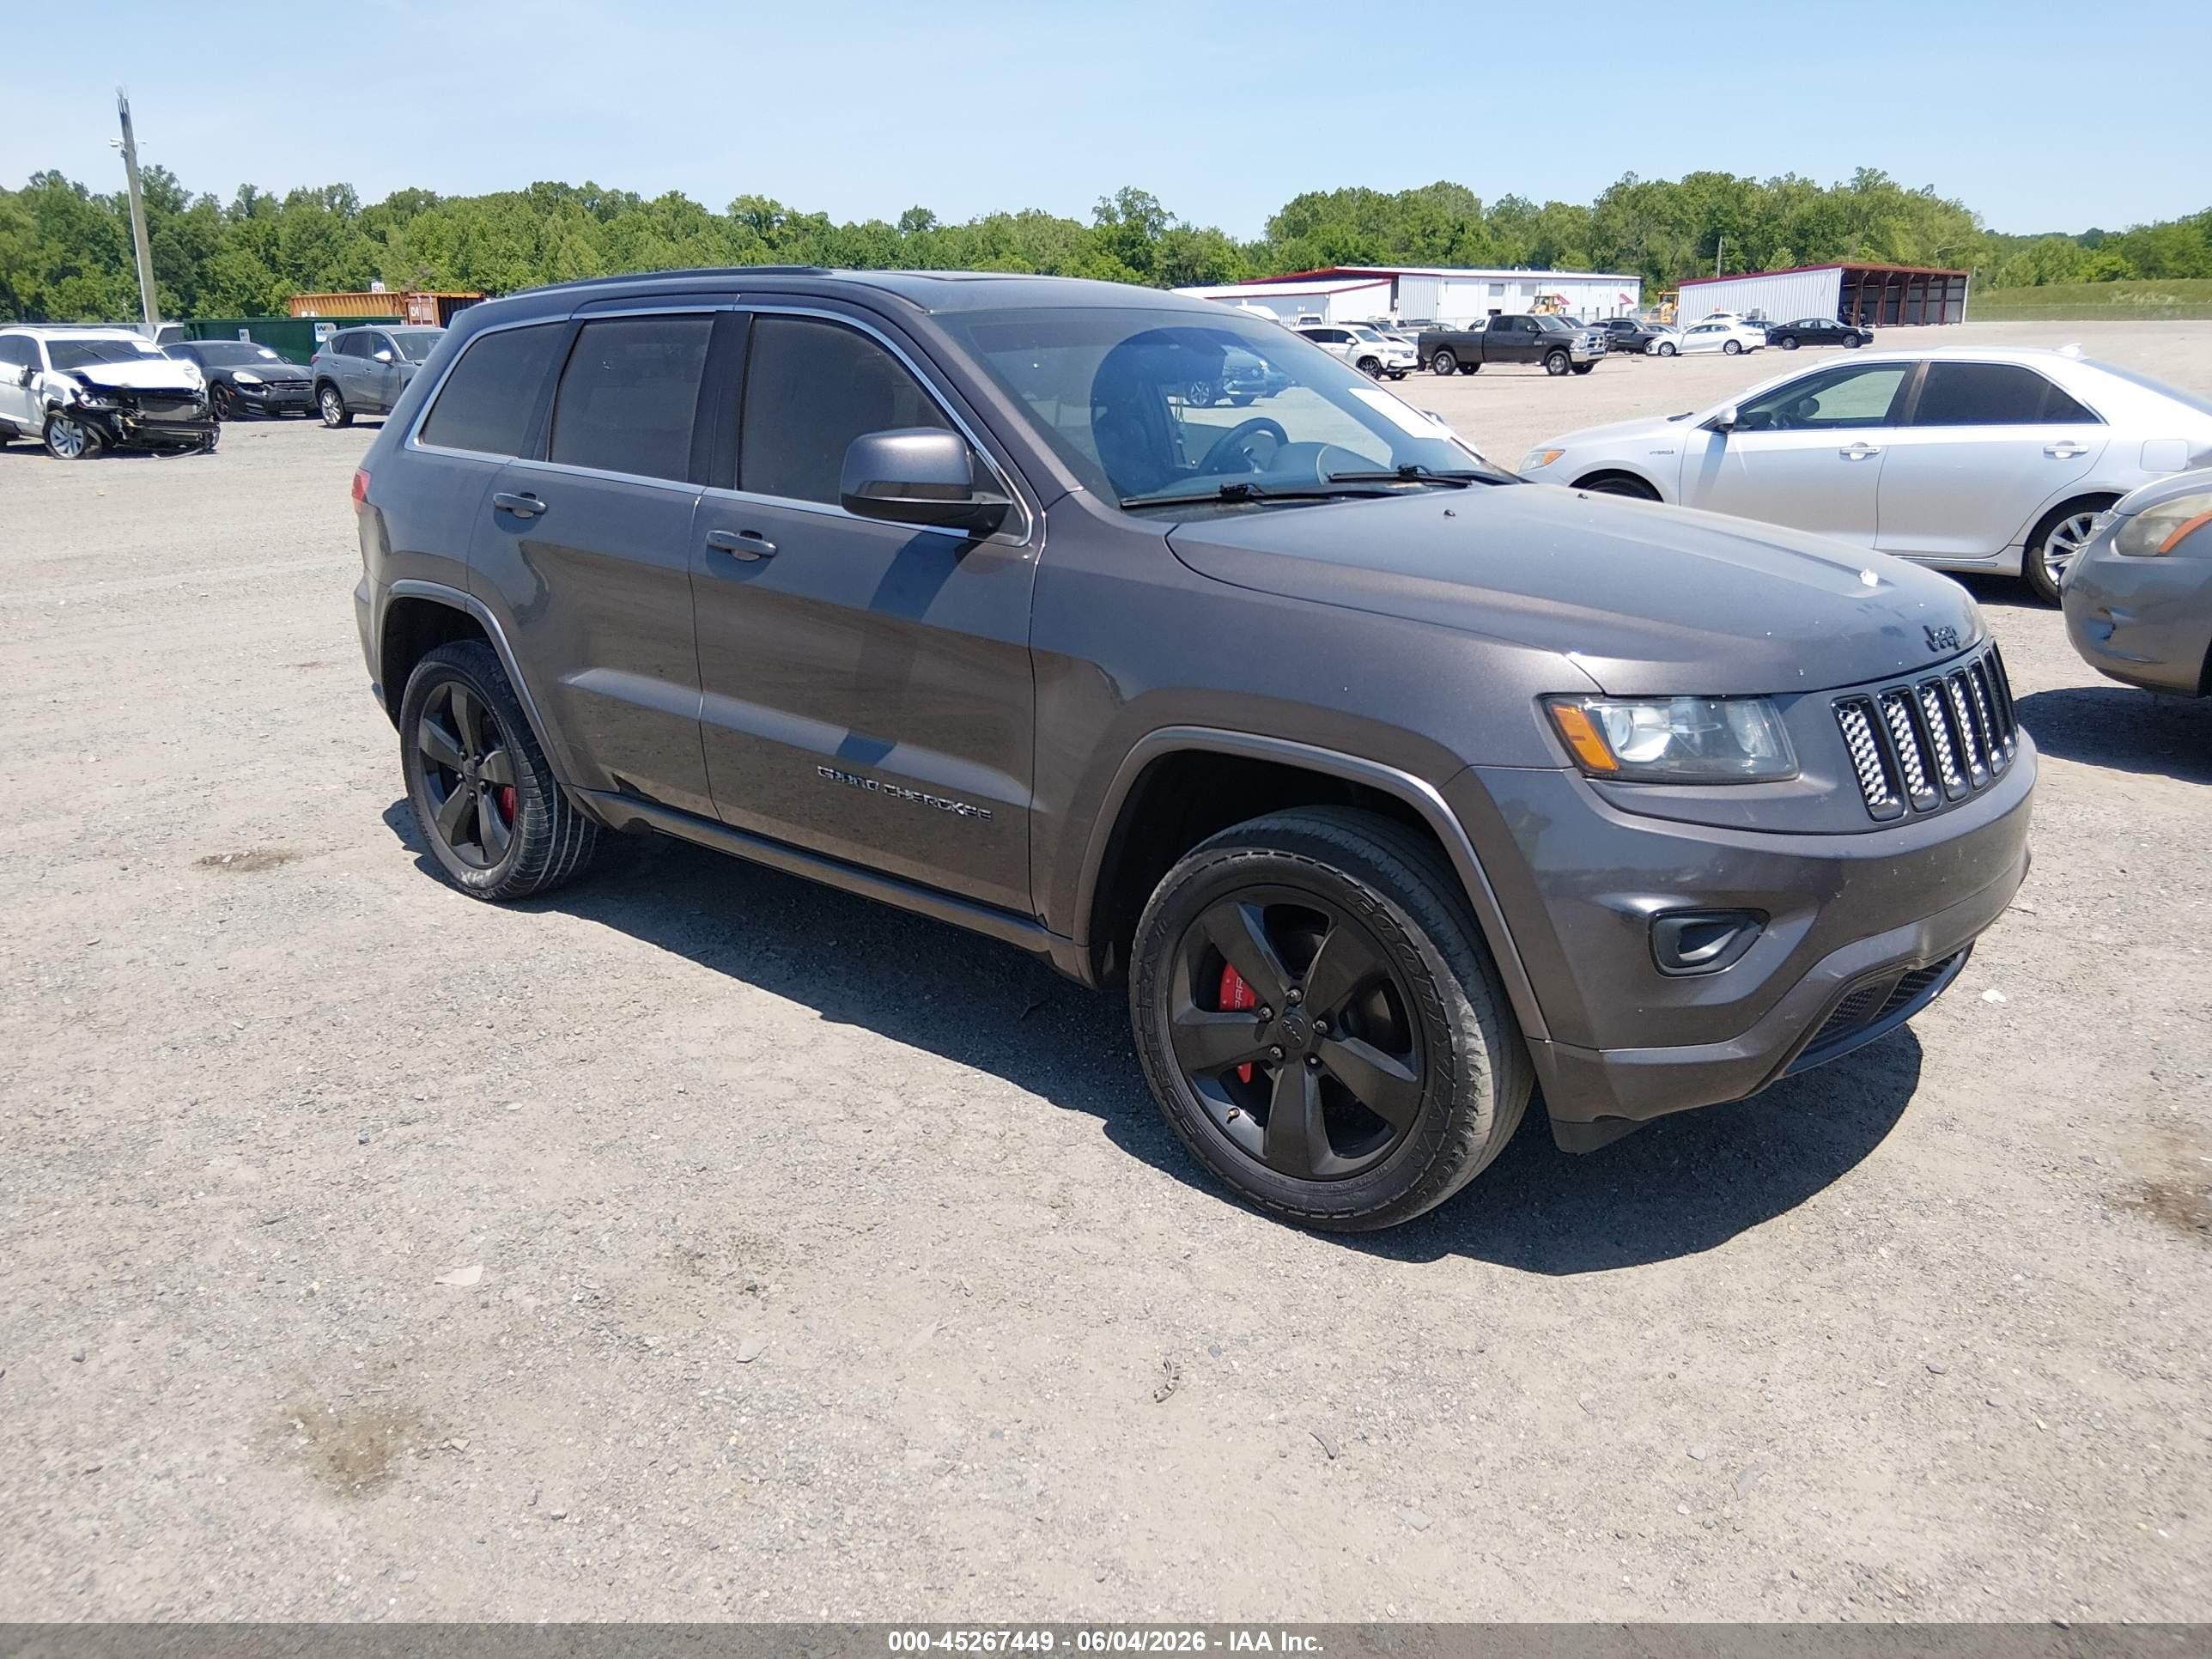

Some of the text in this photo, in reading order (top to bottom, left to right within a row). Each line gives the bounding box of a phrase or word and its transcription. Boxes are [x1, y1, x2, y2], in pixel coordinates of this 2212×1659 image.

[1923, 625, 1960, 653] Jeep
[817, 765, 992, 820] GRAND CHEROKEE
